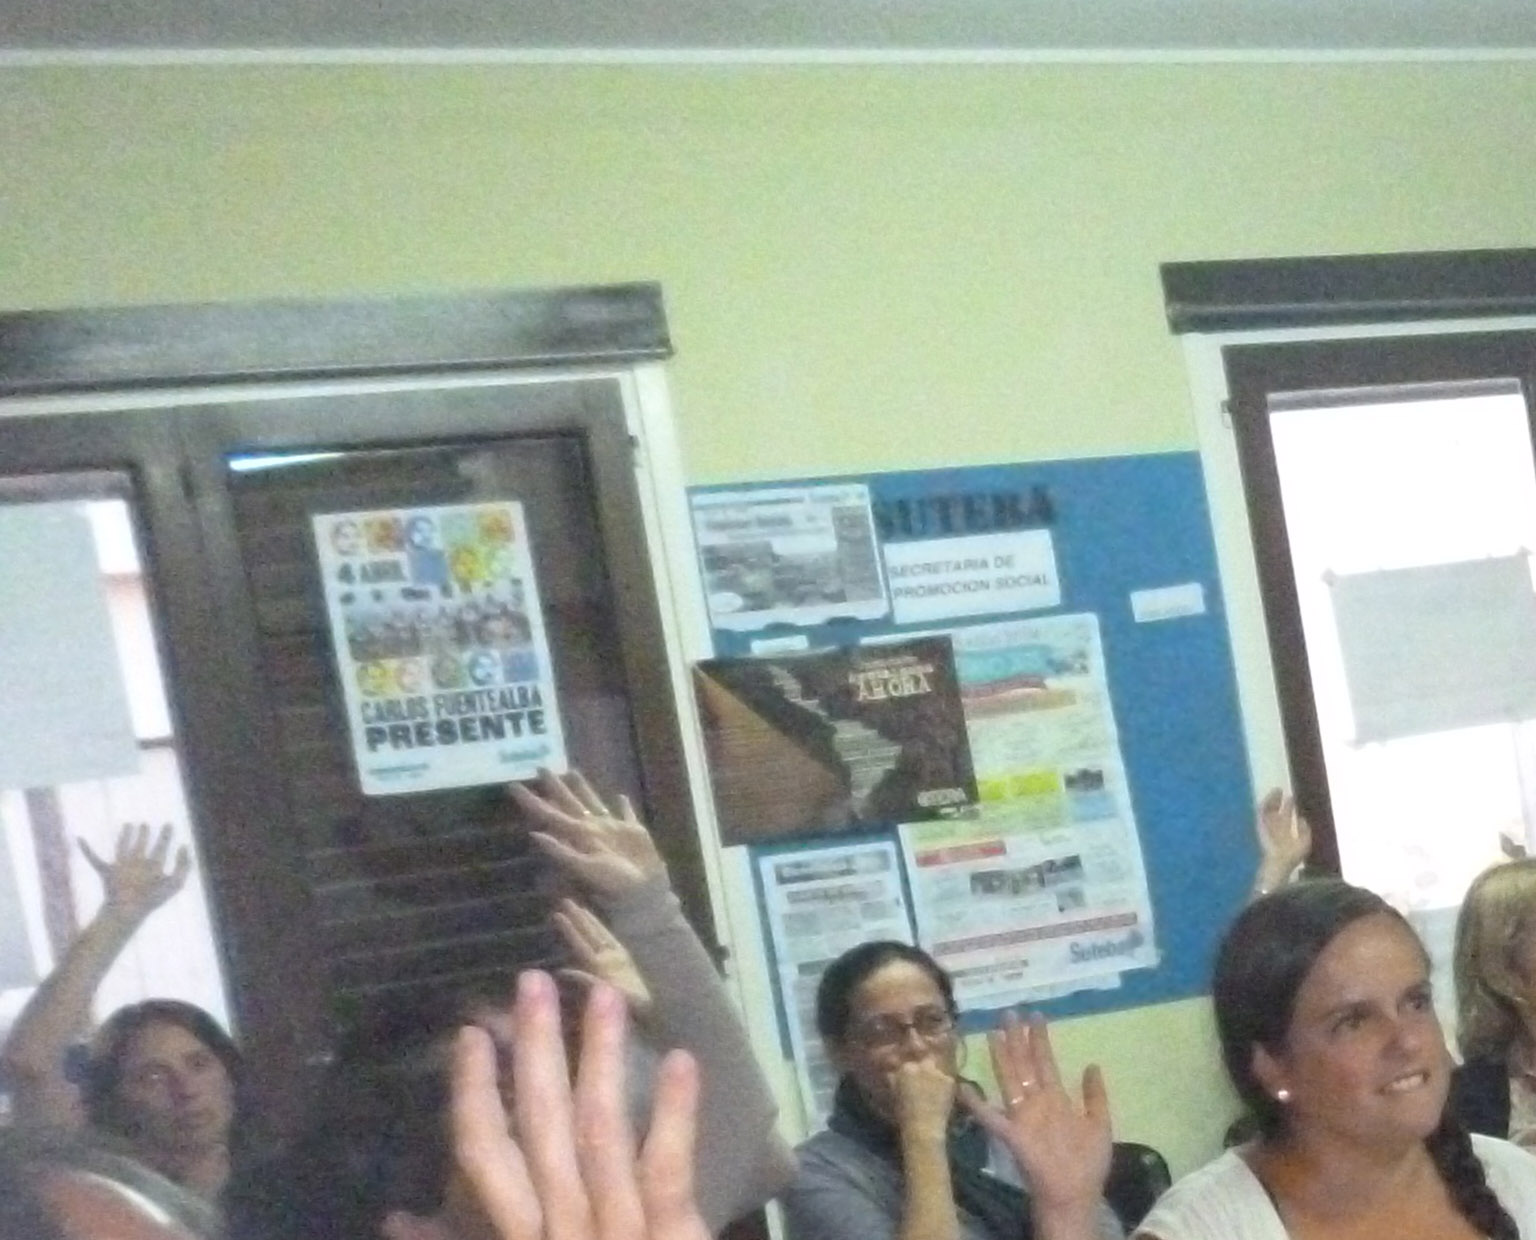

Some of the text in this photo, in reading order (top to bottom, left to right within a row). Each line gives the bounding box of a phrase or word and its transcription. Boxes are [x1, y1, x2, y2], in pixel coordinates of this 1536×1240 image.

[889, 554, 1016, 580] SECRETARIA DE
[893, 573, 1050, 599] PROMOCION SOCIAL
[364, 708, 548, 753] PRESENTE
